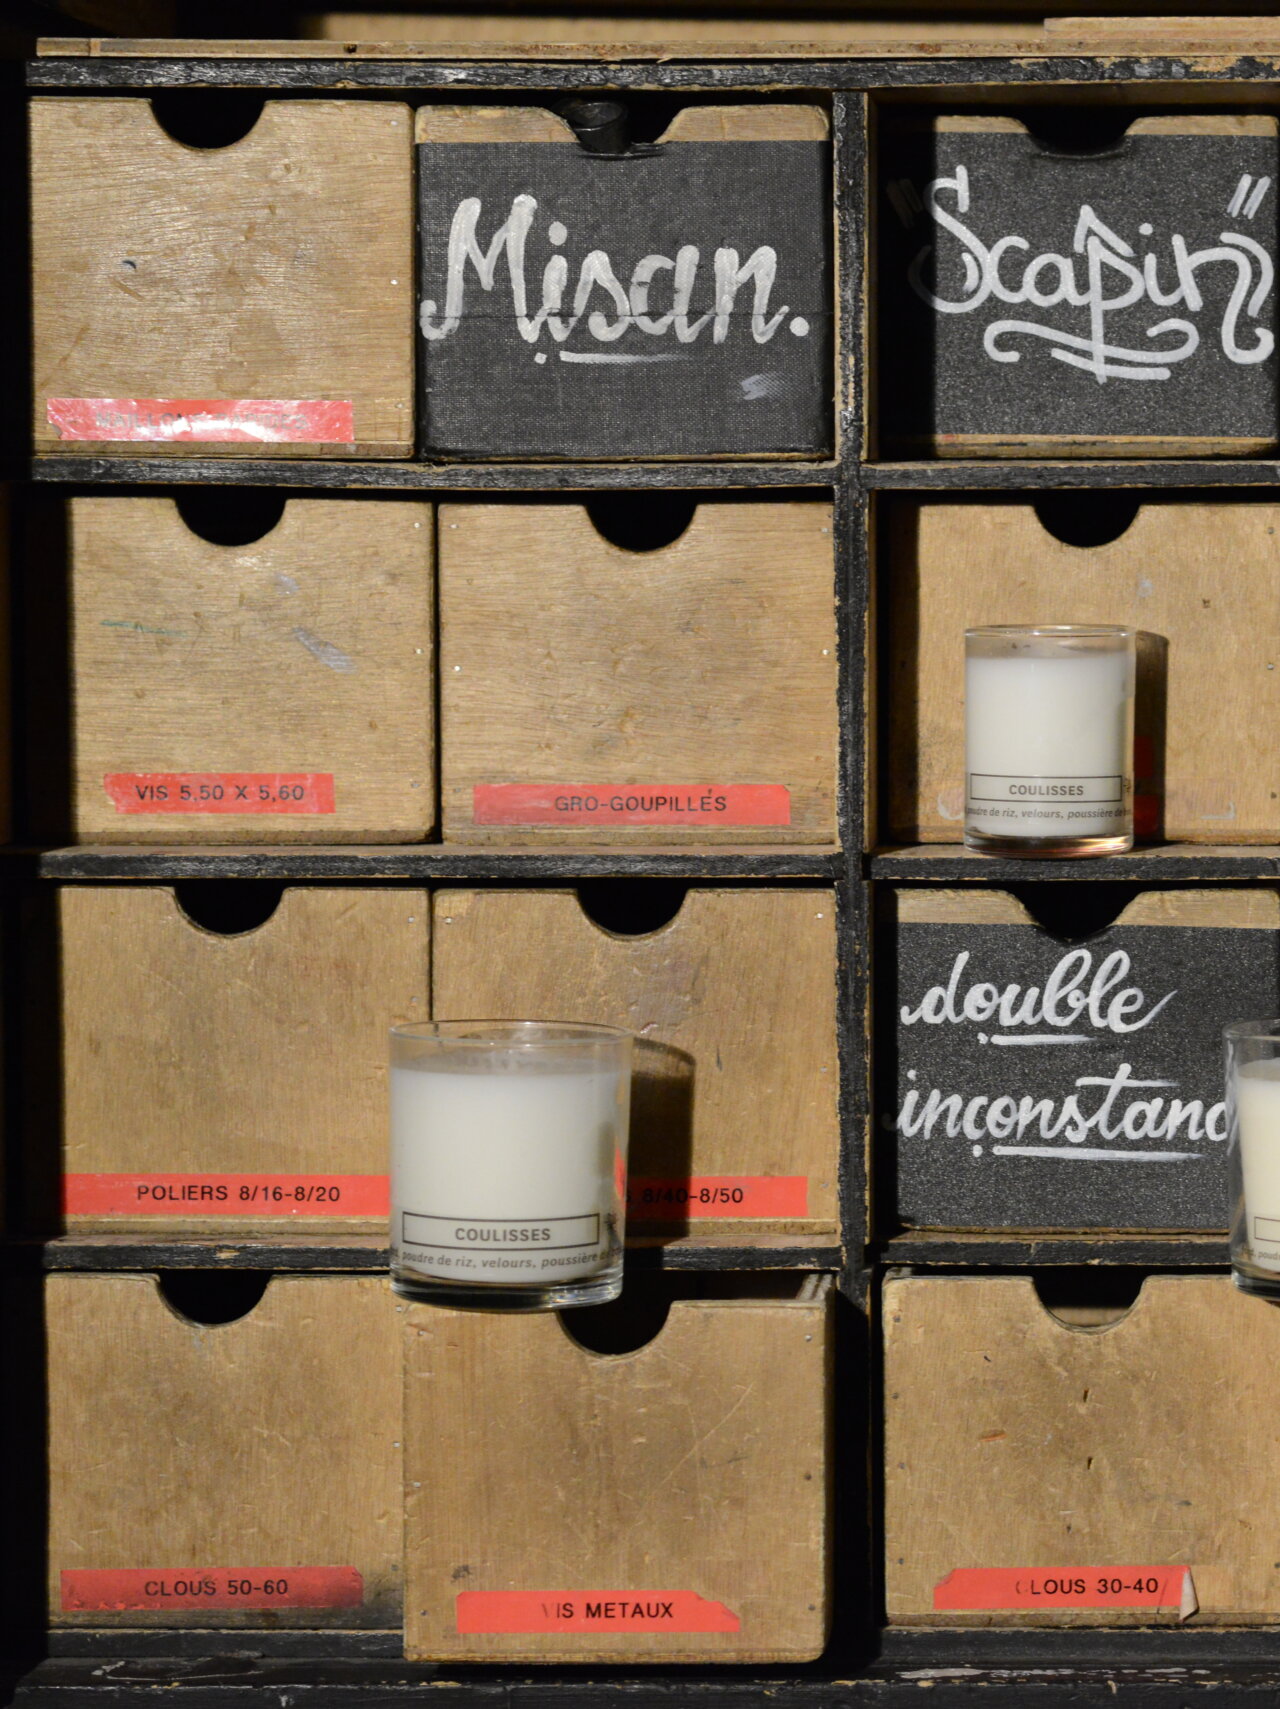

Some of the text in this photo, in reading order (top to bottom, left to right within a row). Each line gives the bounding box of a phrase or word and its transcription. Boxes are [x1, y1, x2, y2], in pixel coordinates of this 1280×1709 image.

[135, 785, 168, 801] VIS
[259, 785, 304, 802] 5,60
[1009, 784, 1084, 796] COULISSES
[989, 808, 1000, 817] de
[1002, 808, 1018, 818] riz,
[1021, 808, 1064, 819] velours,
[1067, 807, 1113, 820] poussière
[899, 948, 1179, 1034] double
[896, 1063, 1229, 1143] inconstanc
[136, 1184, 342, 1203] POLIERS 8/16-8/20
[455, 1227, 551, 1242] COULISSES
[437, 1252, 452, 1266] de
[455, 1255, 478, 1270] riz,
[481, 1256, 536, 1270] velours,
[541, 1252, 598, 1270] poussière
[144, 1579, 288, 1597] CLOUS 50-60
[1096, 1577, 1159, 1594] 30-40
[585, 1602, 674, 1618] METAUX
